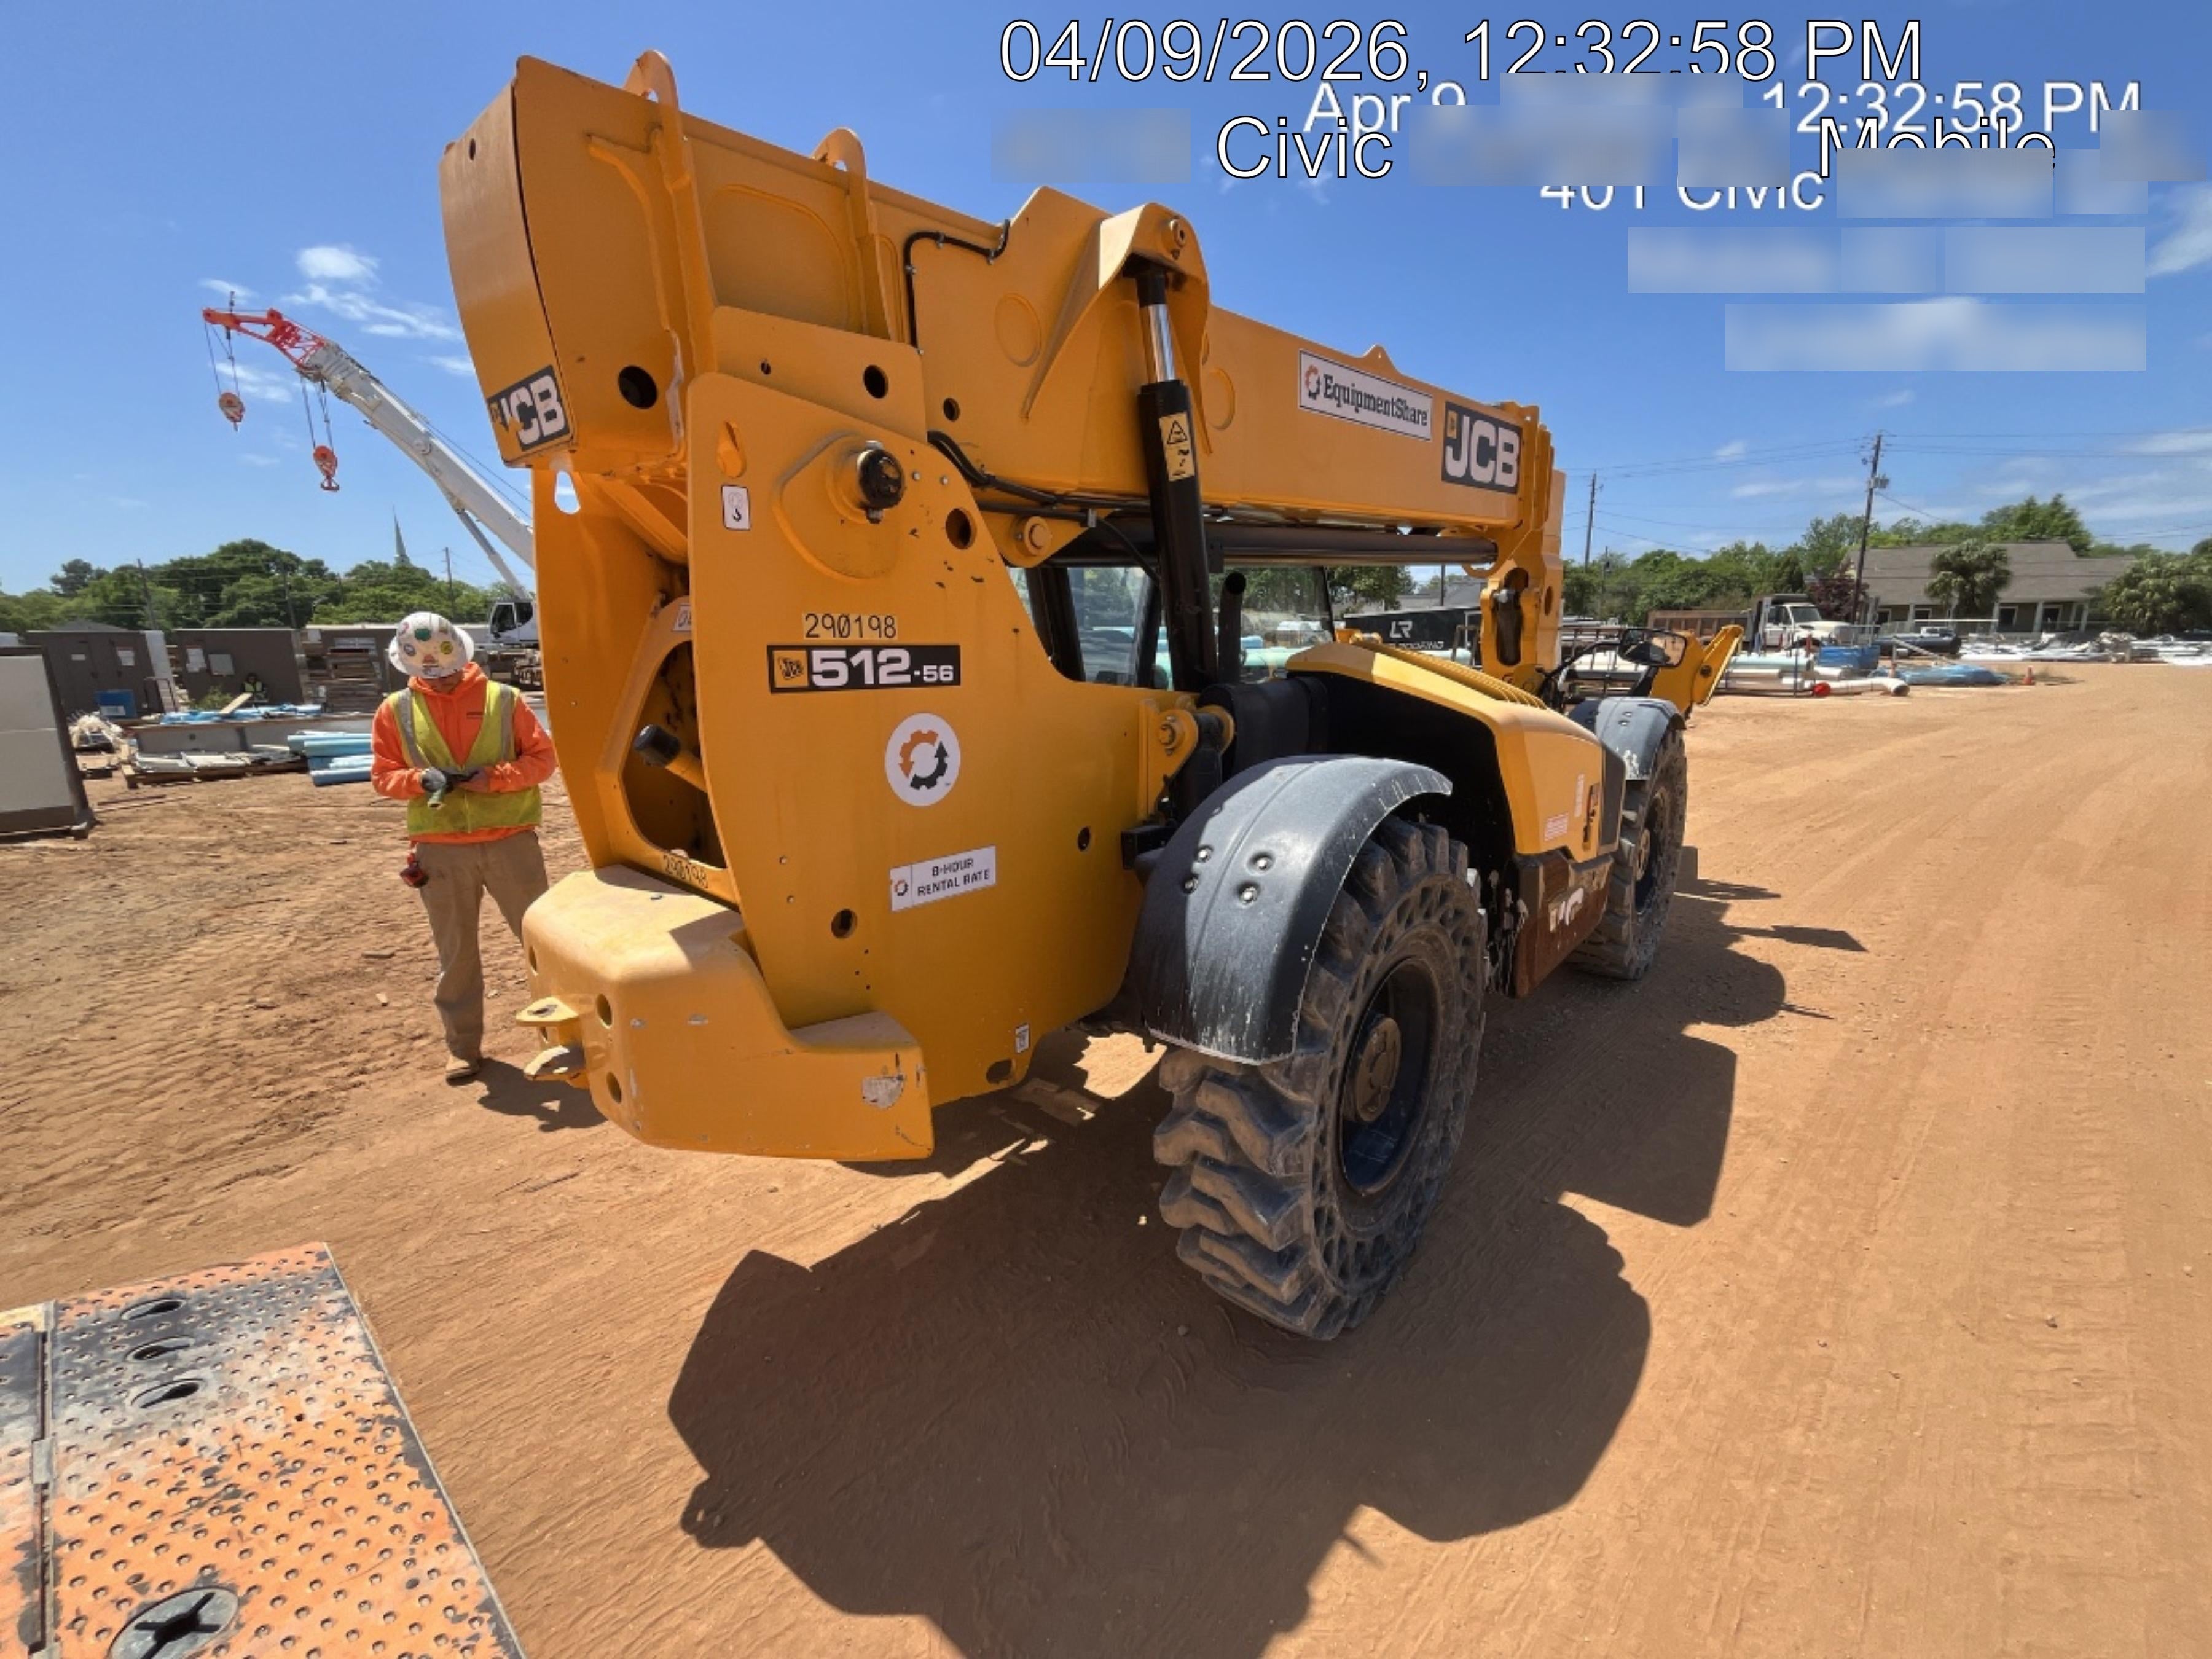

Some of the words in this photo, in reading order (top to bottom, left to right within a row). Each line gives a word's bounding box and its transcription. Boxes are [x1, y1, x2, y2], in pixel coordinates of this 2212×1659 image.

[1323, 374, 1429, 426] EquipmentShare
[1445, 414, 1520, 487] JCB
[805, 613, 896, 638] 290198
[932, 858, 973, 876] 8-HOUR
[917, 879, 960, 896] RENTAL
[963, 869, 989, 885] RATE
